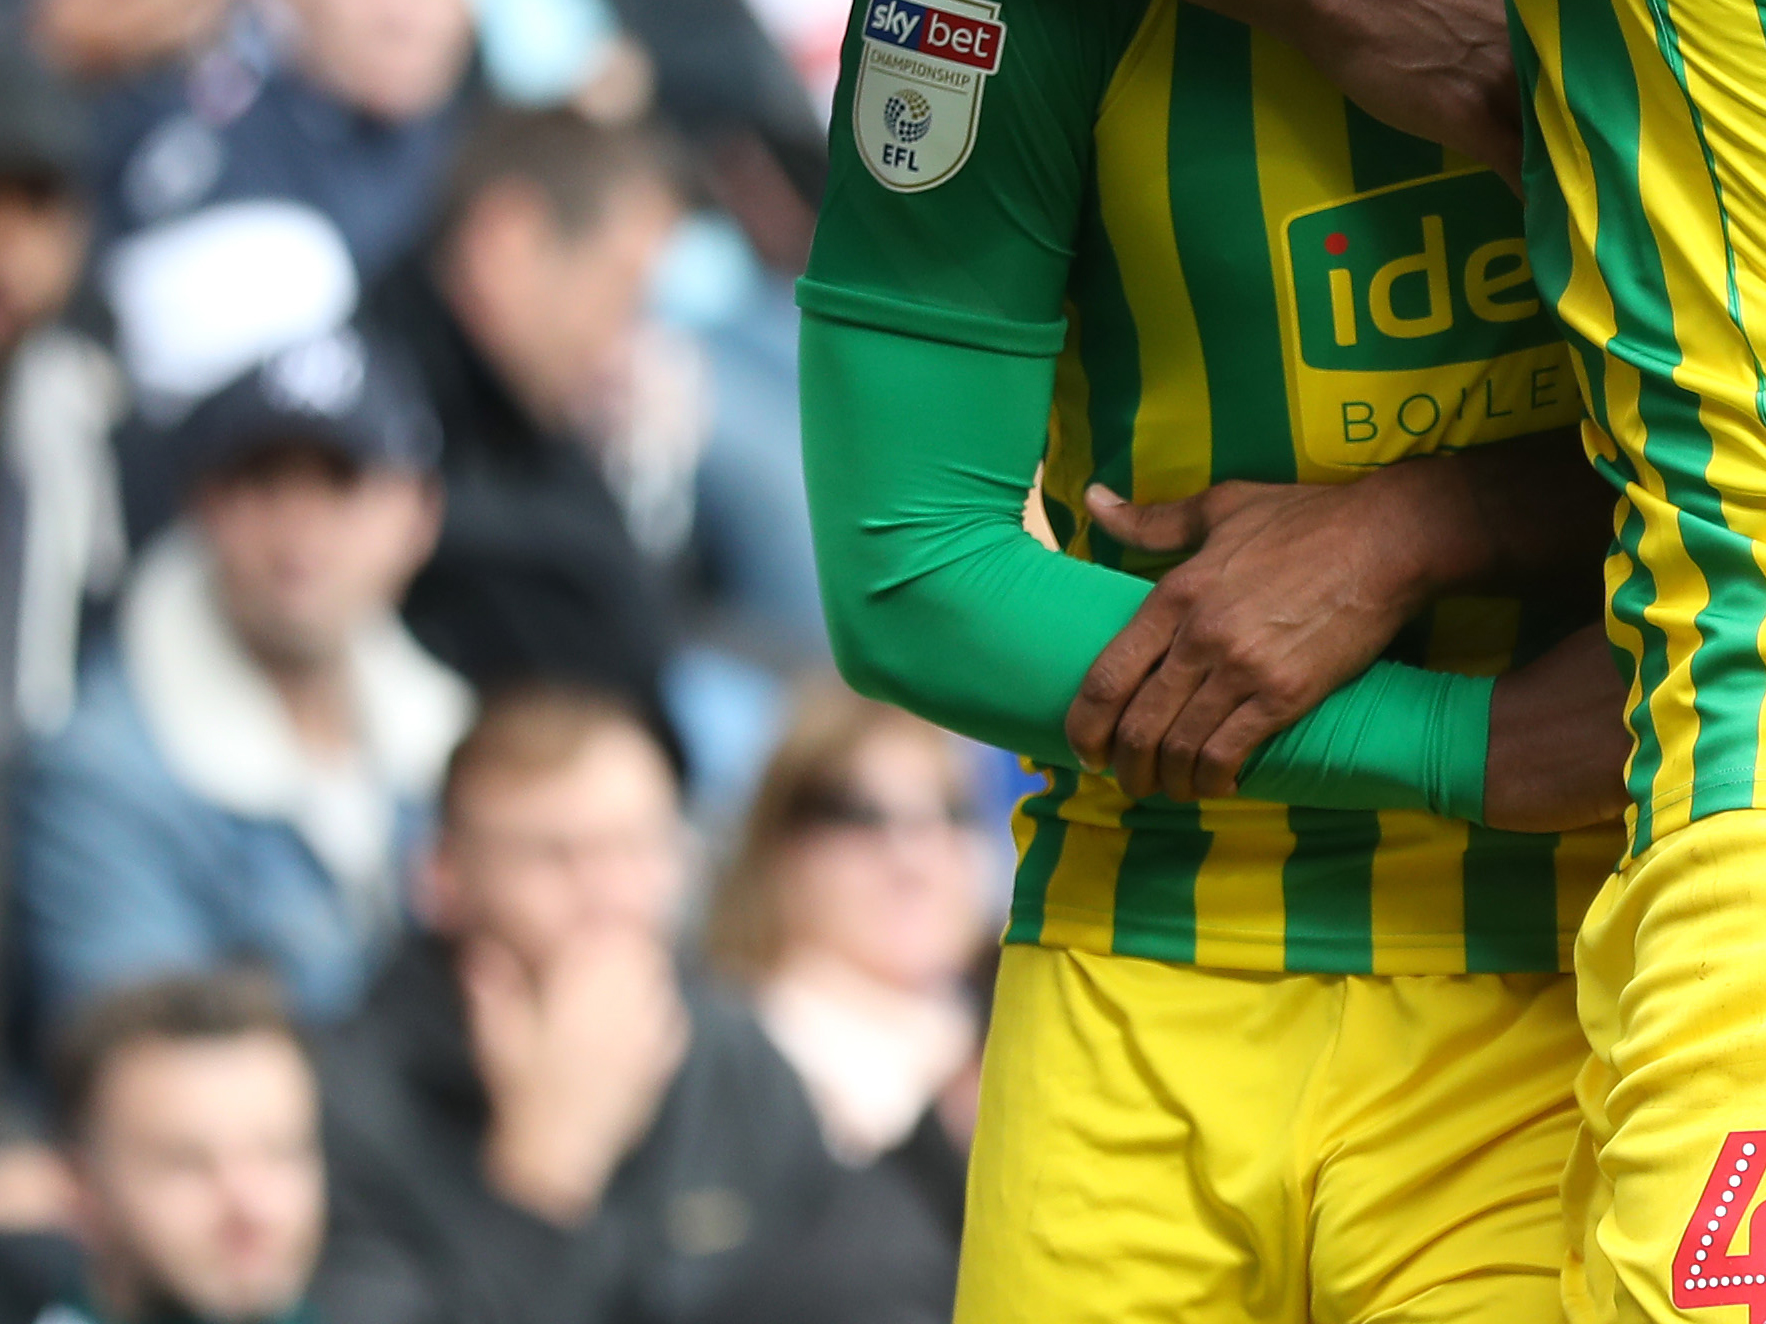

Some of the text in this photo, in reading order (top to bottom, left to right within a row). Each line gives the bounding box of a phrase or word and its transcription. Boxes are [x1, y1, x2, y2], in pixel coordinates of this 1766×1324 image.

[871, 0, 992, 58] sky bet
[869, 48, 972, 89] CHAMPIONSHIP
[882, 143, 921, 173] EFL
[1341, 365, 1585, 445] BOILE
